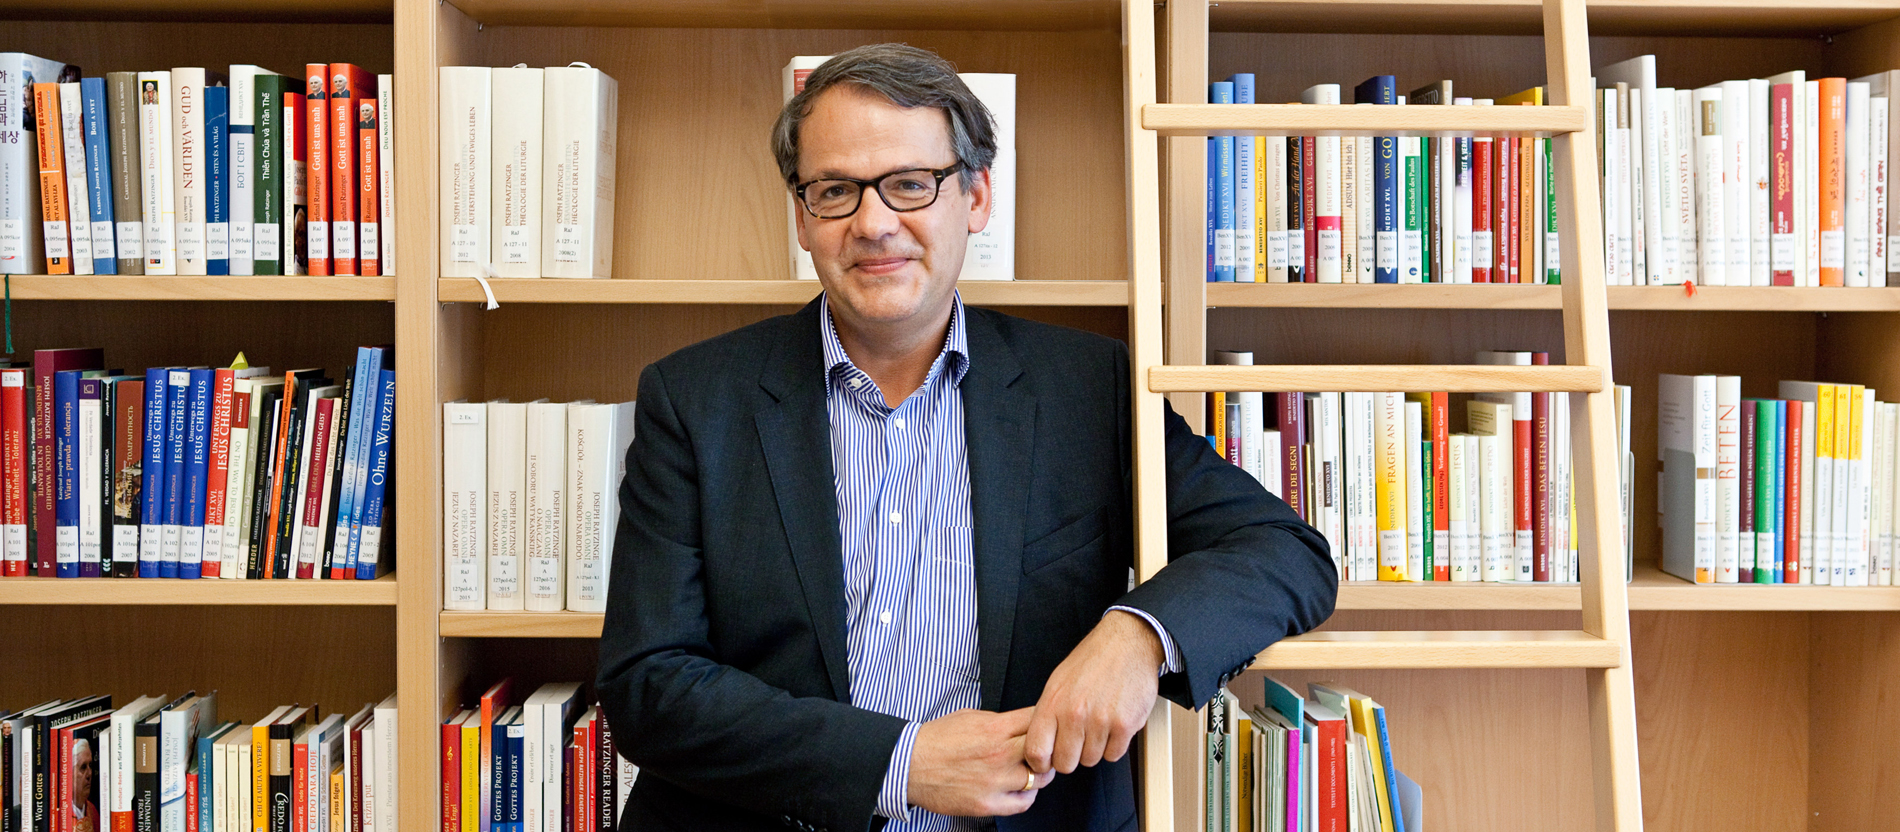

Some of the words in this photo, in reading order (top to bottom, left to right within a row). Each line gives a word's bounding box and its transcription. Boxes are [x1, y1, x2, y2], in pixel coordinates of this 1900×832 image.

[181, 86, 190, 113] GUD
[337, 106, 345, 120] nah
[312, 107, 320, 122] nah
[262, 128, 269, 136] và
[338, 138, 346, 148] ist
[183, 130, 194, 188] VÄRLDEN
[262, 138, 270, 157] Chúa
[313, 152, 321, 170] Gott
[338, 150, 346, 169] Gott
[262, 158, 270, 180] Thiên
[148, 401, 153, 409] zu
[154, 379, 163, 431] CHRISTUS
[176, 386, 185, 431] CHRISTU
[196, 380, 206, 432] CHRISTUS
[216, 393, 222, 403] ZU
[221, 377, 232, 435] CHRISTUS
[1702, 390, 1711, 411] Gott
[64, 402, 72, 436] tolerancja
[376, 380, 394, 446] WURZELN
[1702, 414, 1711, 429] für
[212, 405, 221, 453] UNTERWEGS
[1386, 424, 1395, 442] AN
[1539, 417, 1547, 437] JESU
[38, 446, 43, 455] EN
[153, 435, 161, 463] JESUS
[175, 435, 183, 463] JESUS
[195, 435, 203, 464] JESUS
[218, 439, 228, 470] JESUS
[315, 432, 324, 461] HEILIGEN
[1702, 432, 1711, 453] Zeit
[1719, 404, 1736, 479] BETEN
[65, 444, 73, 470] prawda
[372, 451, 387, 485] Ohne
[1386, 445, 1396, 483] FRAGEN
[576, 494, 584, 521] WŚRÓD
[349, 542, 357, 565] HEYNE
[602, 732, 611, 787] RATZINGER
[35, 773, 43, 800] Gottes
[364, 785, 374, 798] put
[364, 801, 372, 825] Križni
[602, 790, 610, 828] READER
